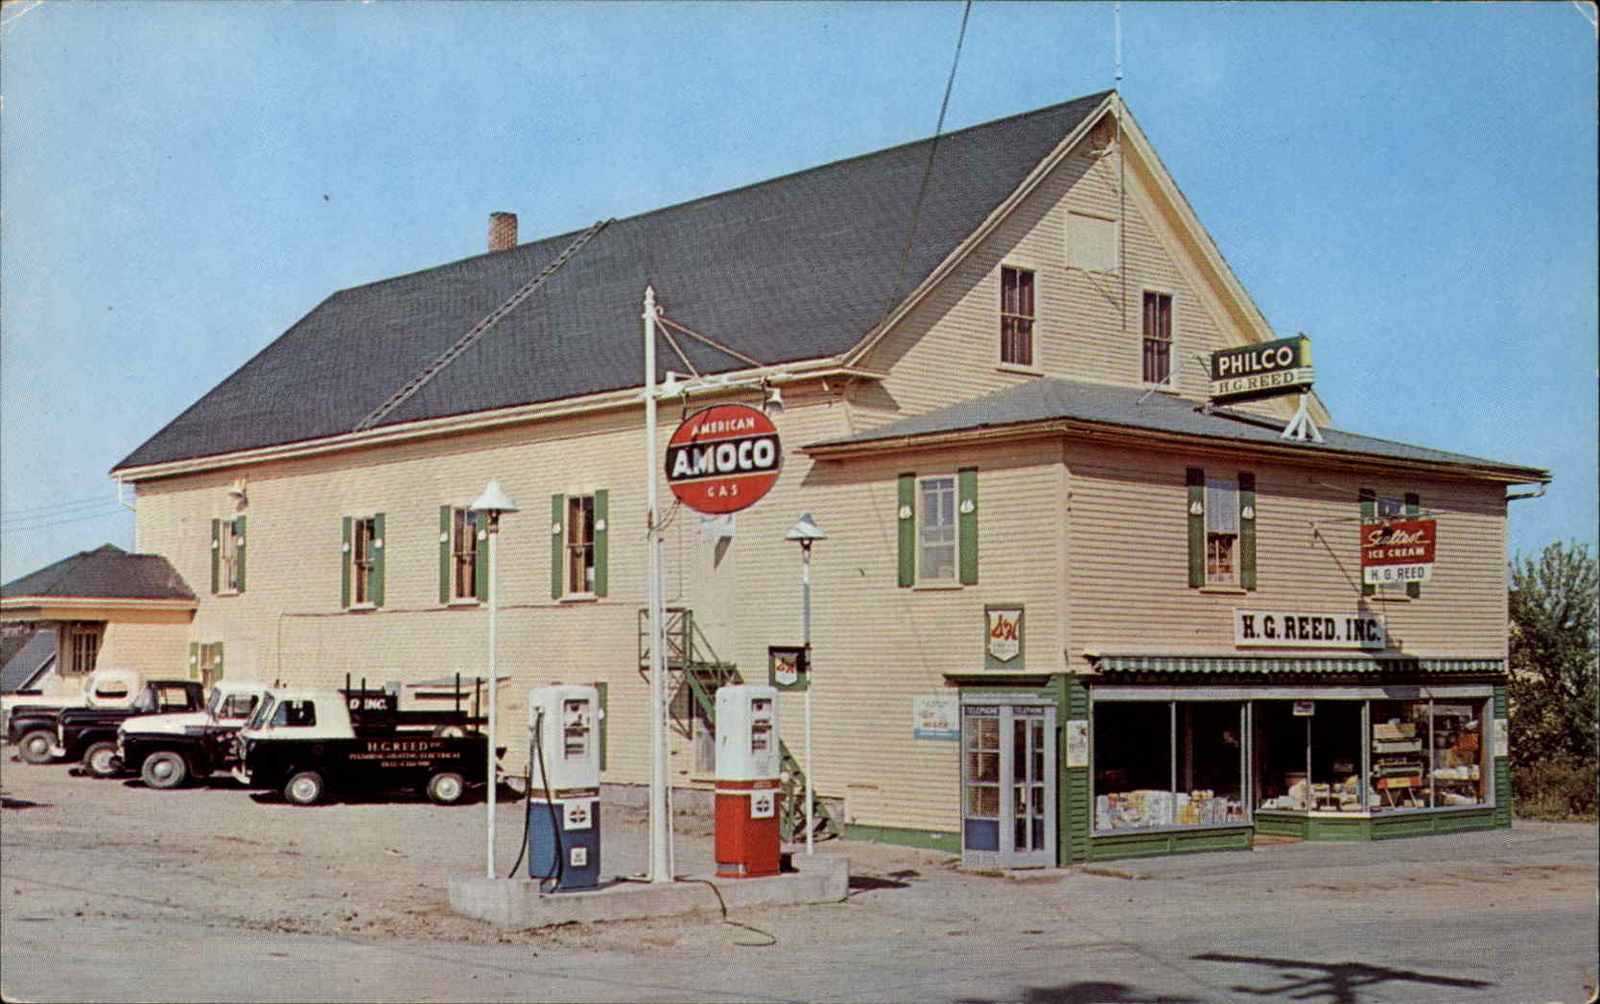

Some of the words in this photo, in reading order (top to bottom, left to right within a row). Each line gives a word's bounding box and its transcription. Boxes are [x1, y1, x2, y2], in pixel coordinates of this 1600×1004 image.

[1218, 346, 1294, 377] PHILCO
[691, 417, 755, 437] AMERICAN
[671, 438, 775, 478] AMOCO
[707, 484, 738, 498] GAS
[1368, 549, 1384, 559] ICE
[1388, 547, 1425, 558] CREAM
[1397, 566, 1425, 579] REED
[1346, 618, 1381, 641] INC.
